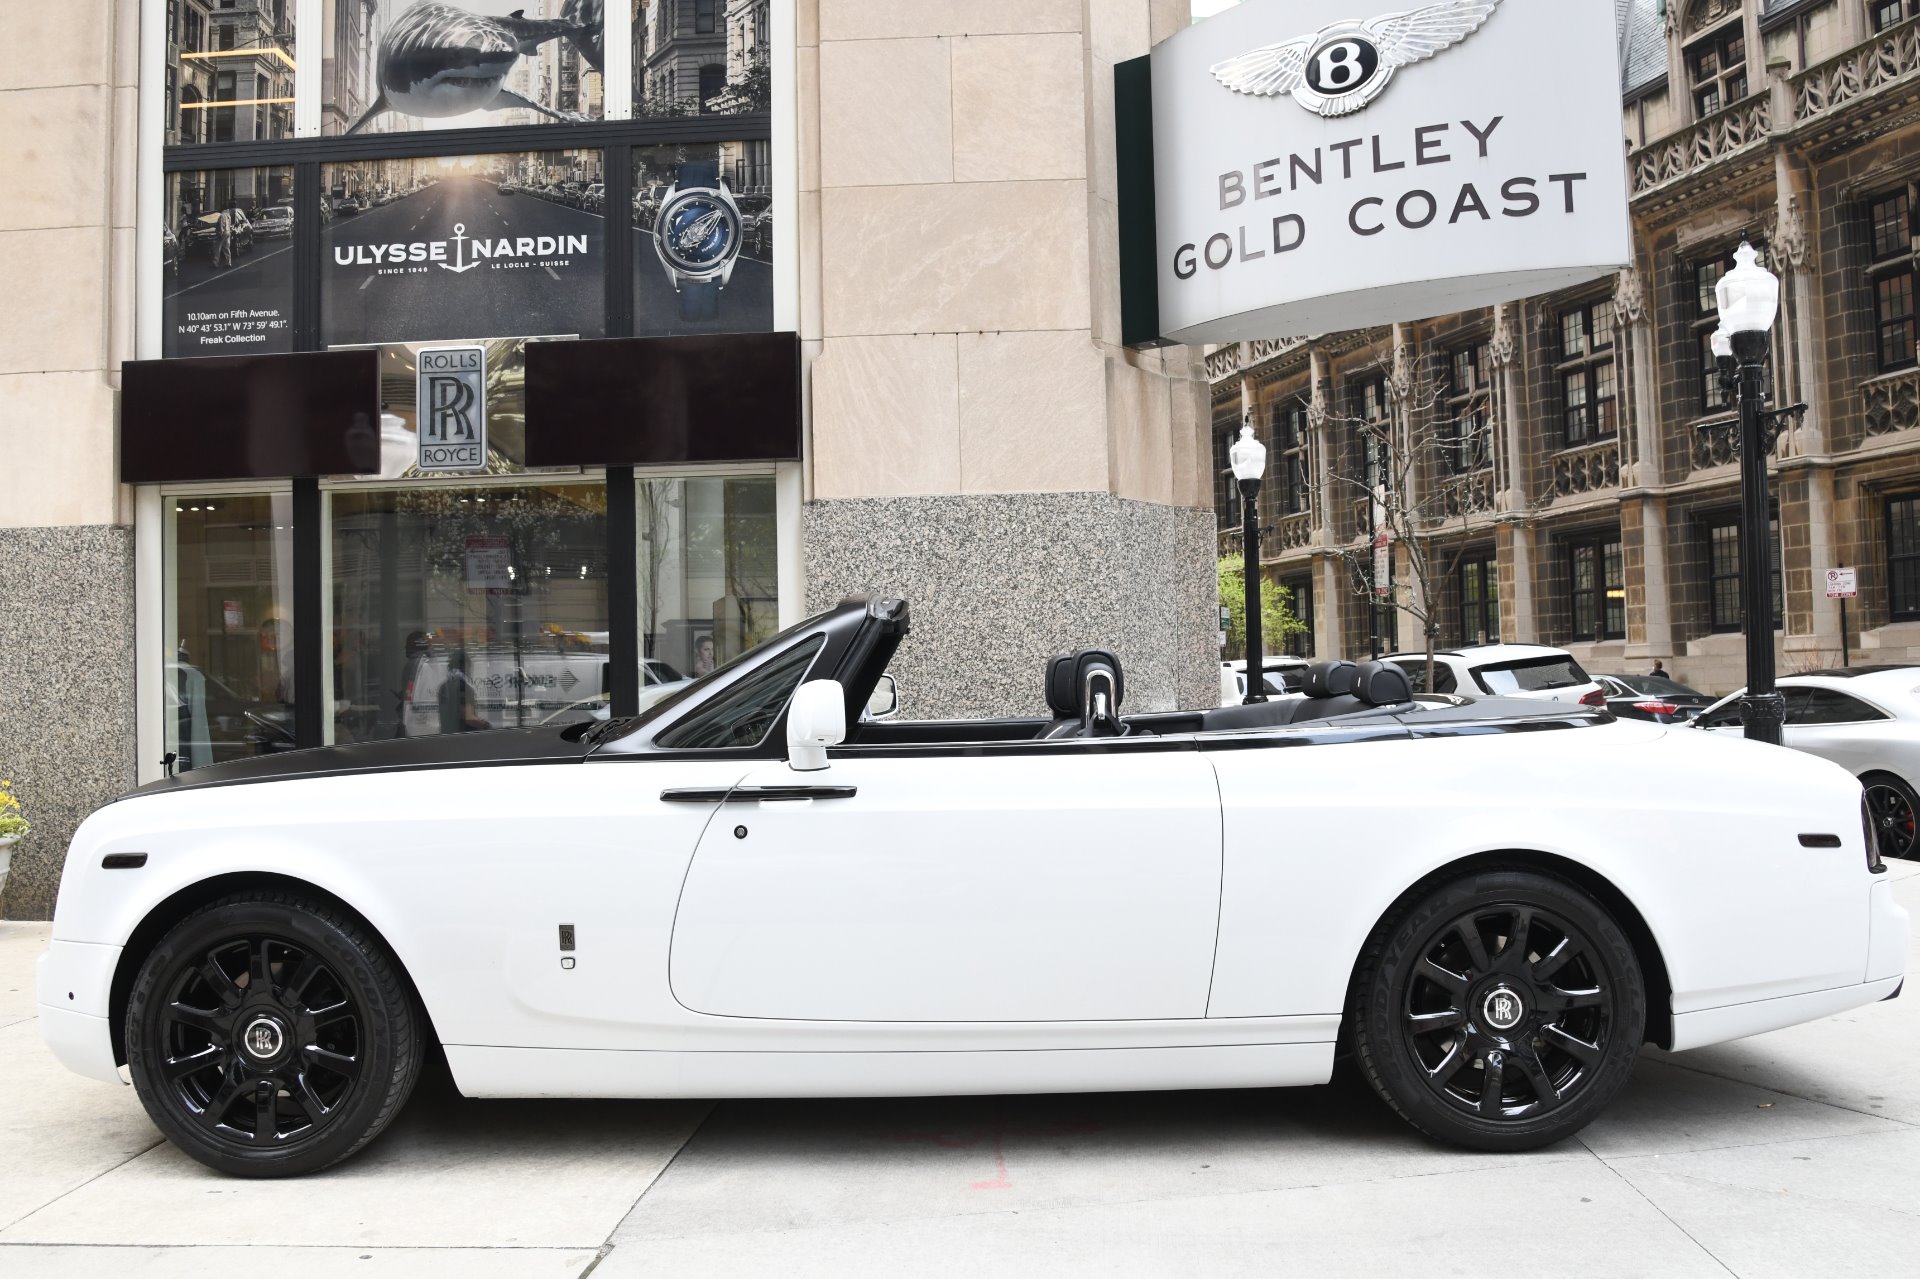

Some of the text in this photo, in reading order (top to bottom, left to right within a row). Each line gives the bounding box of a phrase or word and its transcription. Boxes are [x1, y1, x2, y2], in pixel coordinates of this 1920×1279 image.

[1317, 40, 1363, 90] B
[1219, 115, 1504, 211] BENTLEY
[1173, 172, 1587, 280] GOLD COAST
[334, 234, 588, 266] ULYSSE NARDIN
[377, 267, 404, 275] SINCE
[187, 312, 217, 321] 10.10am
[230, 309, 248, 319] Fifth
[249, 309, 280, 318] Avenue.
[178, 325, 185, 334] N
[186, 324, 200, 333] 40°
[232, 322, 241, 331] W
[242, 321, 255, 330] 73°
[200, 333, 266, 345] Freak Collection
[424, 353, 477, 369] ROLLS
[428, 376, 475, 441] RR
[424, 447, 478, 463] ROYCE
[1494, 997, 1512, 1020] RR
[255, 1027, 273, 1050] RR
